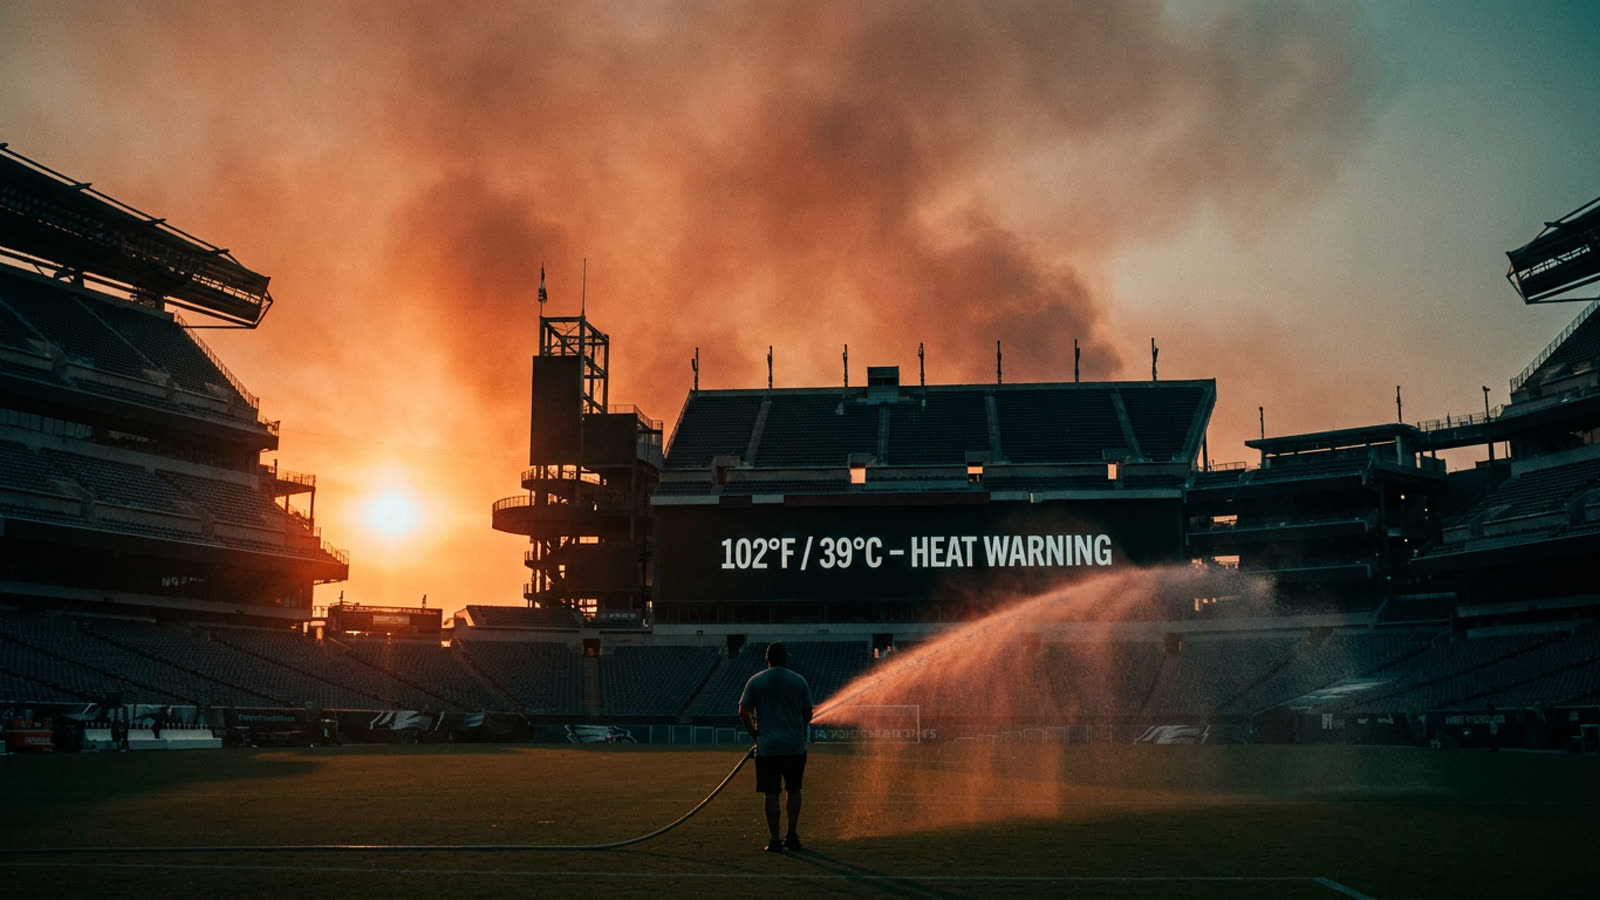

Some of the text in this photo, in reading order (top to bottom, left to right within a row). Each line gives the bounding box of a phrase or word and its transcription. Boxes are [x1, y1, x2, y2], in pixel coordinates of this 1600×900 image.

[721, 537, 795, 569] 102°F
[801, 536, 813, 571] /
[819, 536, 882, 568] 39°C
[911, 536, 977, 568] HEAT
[984, 535, 1112, 567] WARNING
